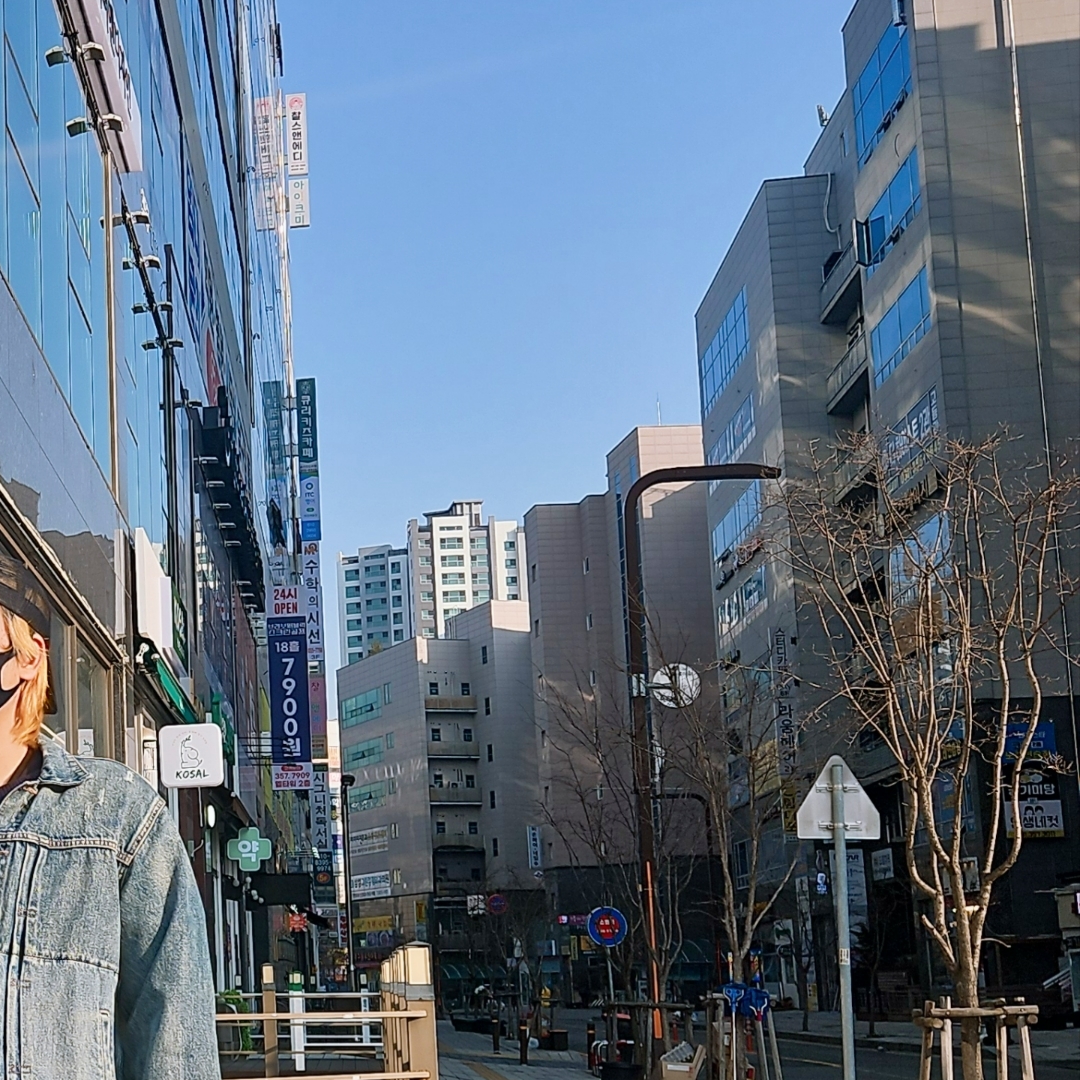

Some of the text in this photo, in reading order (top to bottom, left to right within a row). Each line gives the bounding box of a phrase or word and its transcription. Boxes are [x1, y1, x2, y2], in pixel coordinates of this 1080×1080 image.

[300, 395, 313, 458] 큐리키즈카페
[273, 588, 298, 601] 24시
[274, 602, 298, 615] OPEN
[274, 641, 300, 652] 18홀
[175, 769, 209, 779] KOSAL
[1008, 784, 1055, 796] 기미당
[237, 840, 259, 863] 약
